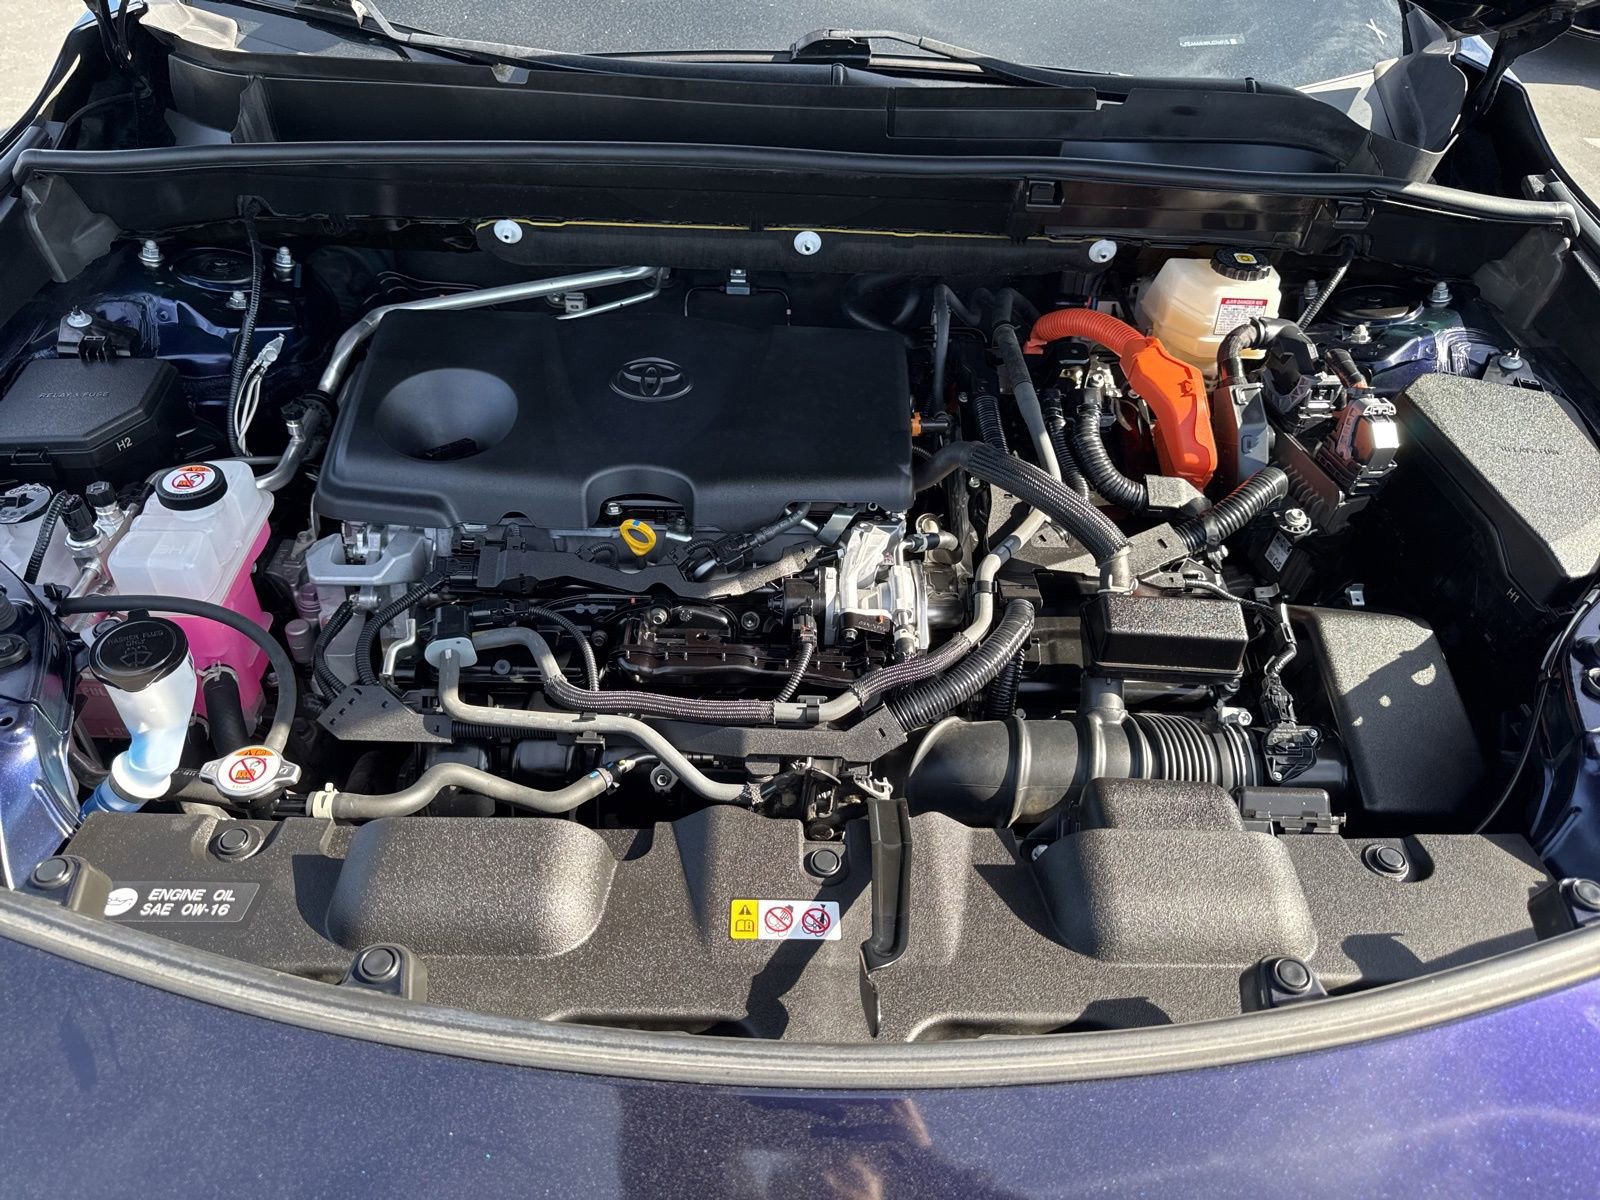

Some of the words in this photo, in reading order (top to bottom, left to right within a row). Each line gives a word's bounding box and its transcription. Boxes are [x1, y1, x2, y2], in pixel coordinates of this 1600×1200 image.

[116, 436, 133, 452] H2
[1506, 587, 1520, 603] H1
[148, 888, 206, 901] ENGINE
[213, 889, 236, 902] OIL
[140, 903, 174, 916] SAE
[181, 903, 231, 917] 0W-16
